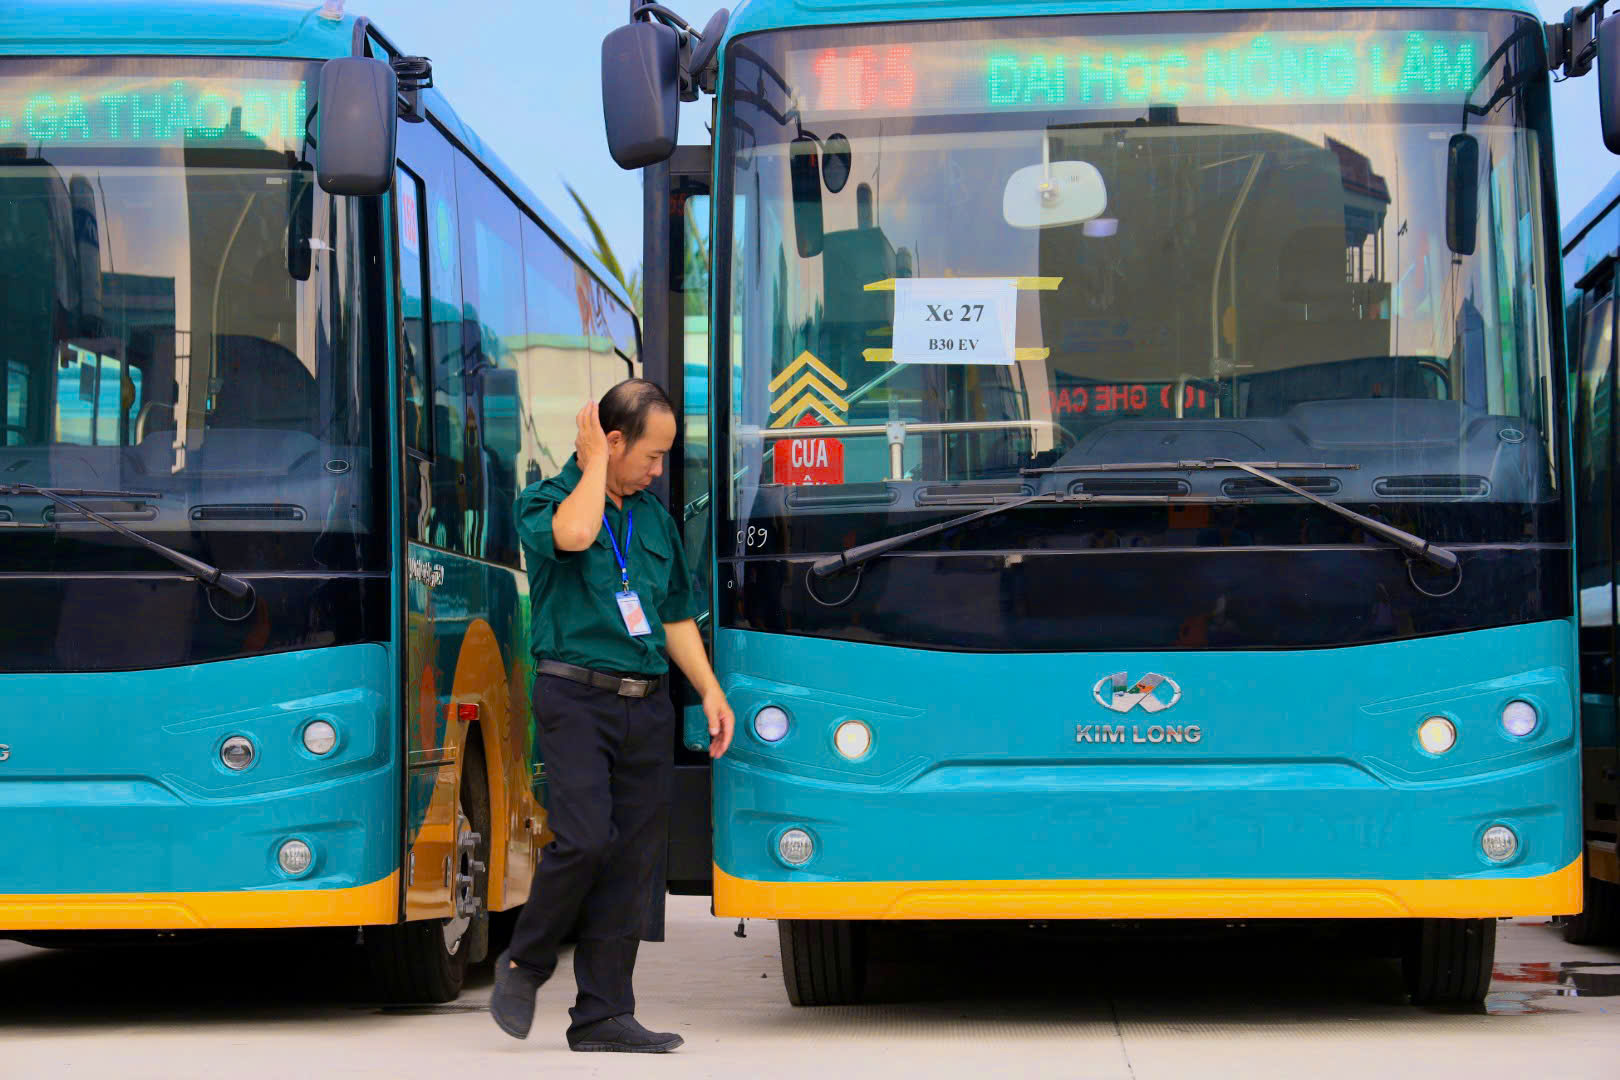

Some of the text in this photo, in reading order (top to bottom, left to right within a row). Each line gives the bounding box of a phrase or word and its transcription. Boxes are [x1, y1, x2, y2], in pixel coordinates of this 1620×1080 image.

[1206, 38, 1353, 98] NÔNG
[1370, 32, 1474, 95] LÂM
[24, 94, 89, 139] GA
[925, 304, 985, 322] Xe 27
[928, 338, 979, 351] B30 EV
[1076, 724, 1201, 743] KIM LONG
